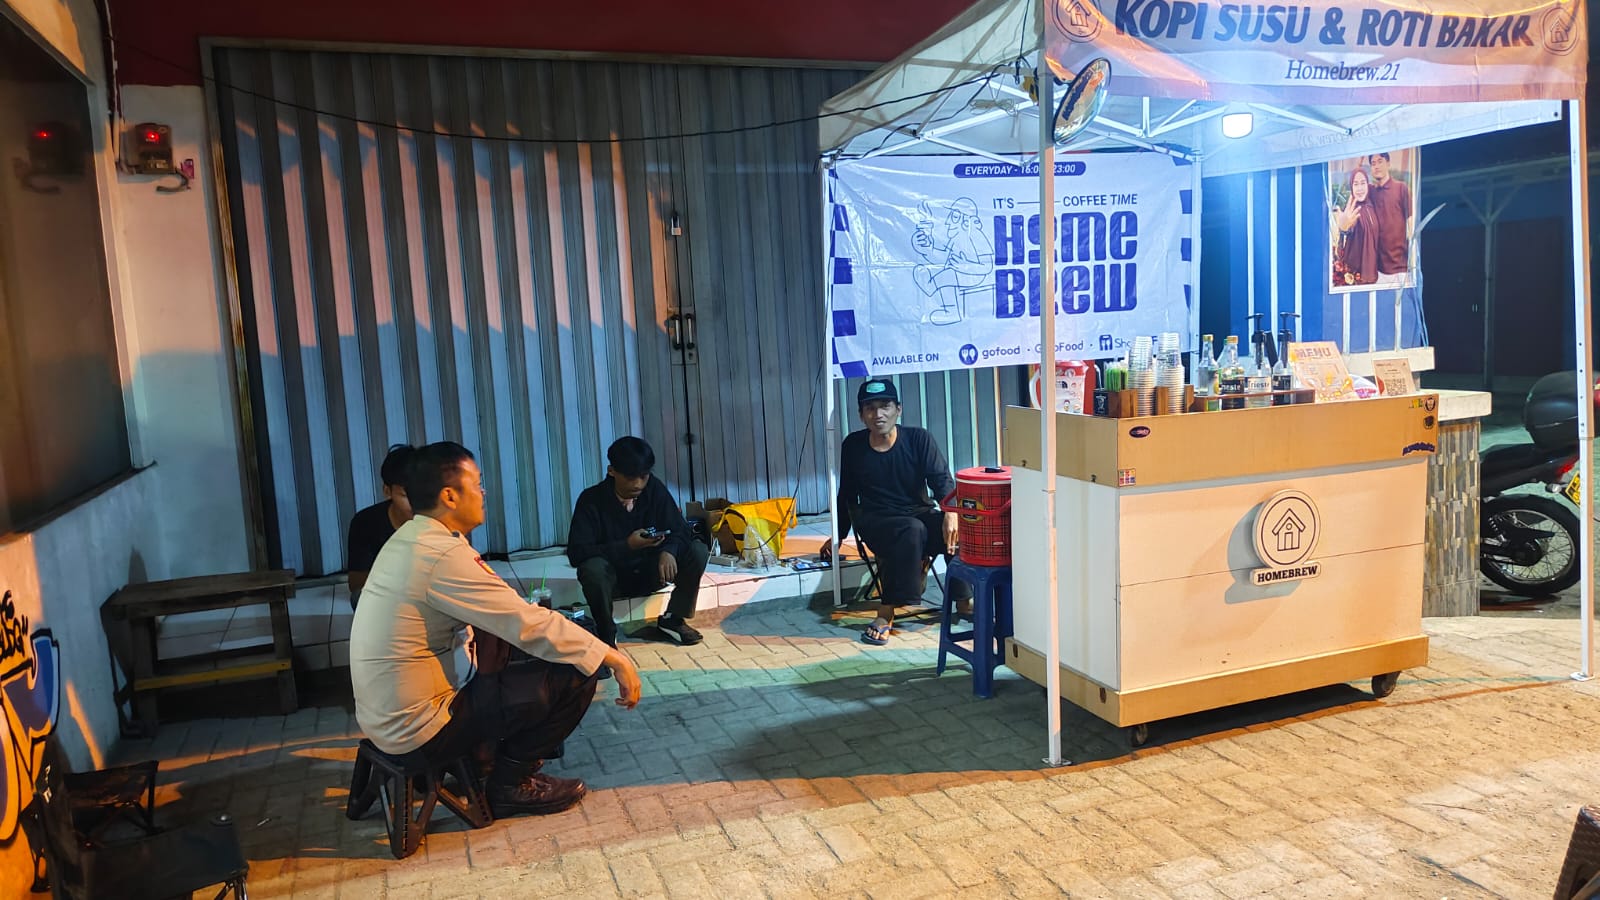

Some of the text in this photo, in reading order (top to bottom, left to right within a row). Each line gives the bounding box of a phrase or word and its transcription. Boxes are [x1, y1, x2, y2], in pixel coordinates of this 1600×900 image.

[1115, 0, 1534, 48] KOPI SUSU & ROTI BAKAR
[1285, 60, 1400, 80] Homebrew.21
[964, 166, 1012, 176] EVERYDAY
[1021, 165, 1040, 175] 16:0
[1053, 164, 1076, 173] 23:00
[992, 193, 1138, 209] IT'S COFFEE TIME
[872, 340, 1084, 366] AVAILABLE ON gofood GFood
[1294, 347, 1332, 358] MENU
[1257, 565, 1318, 583] HOMEBREW
